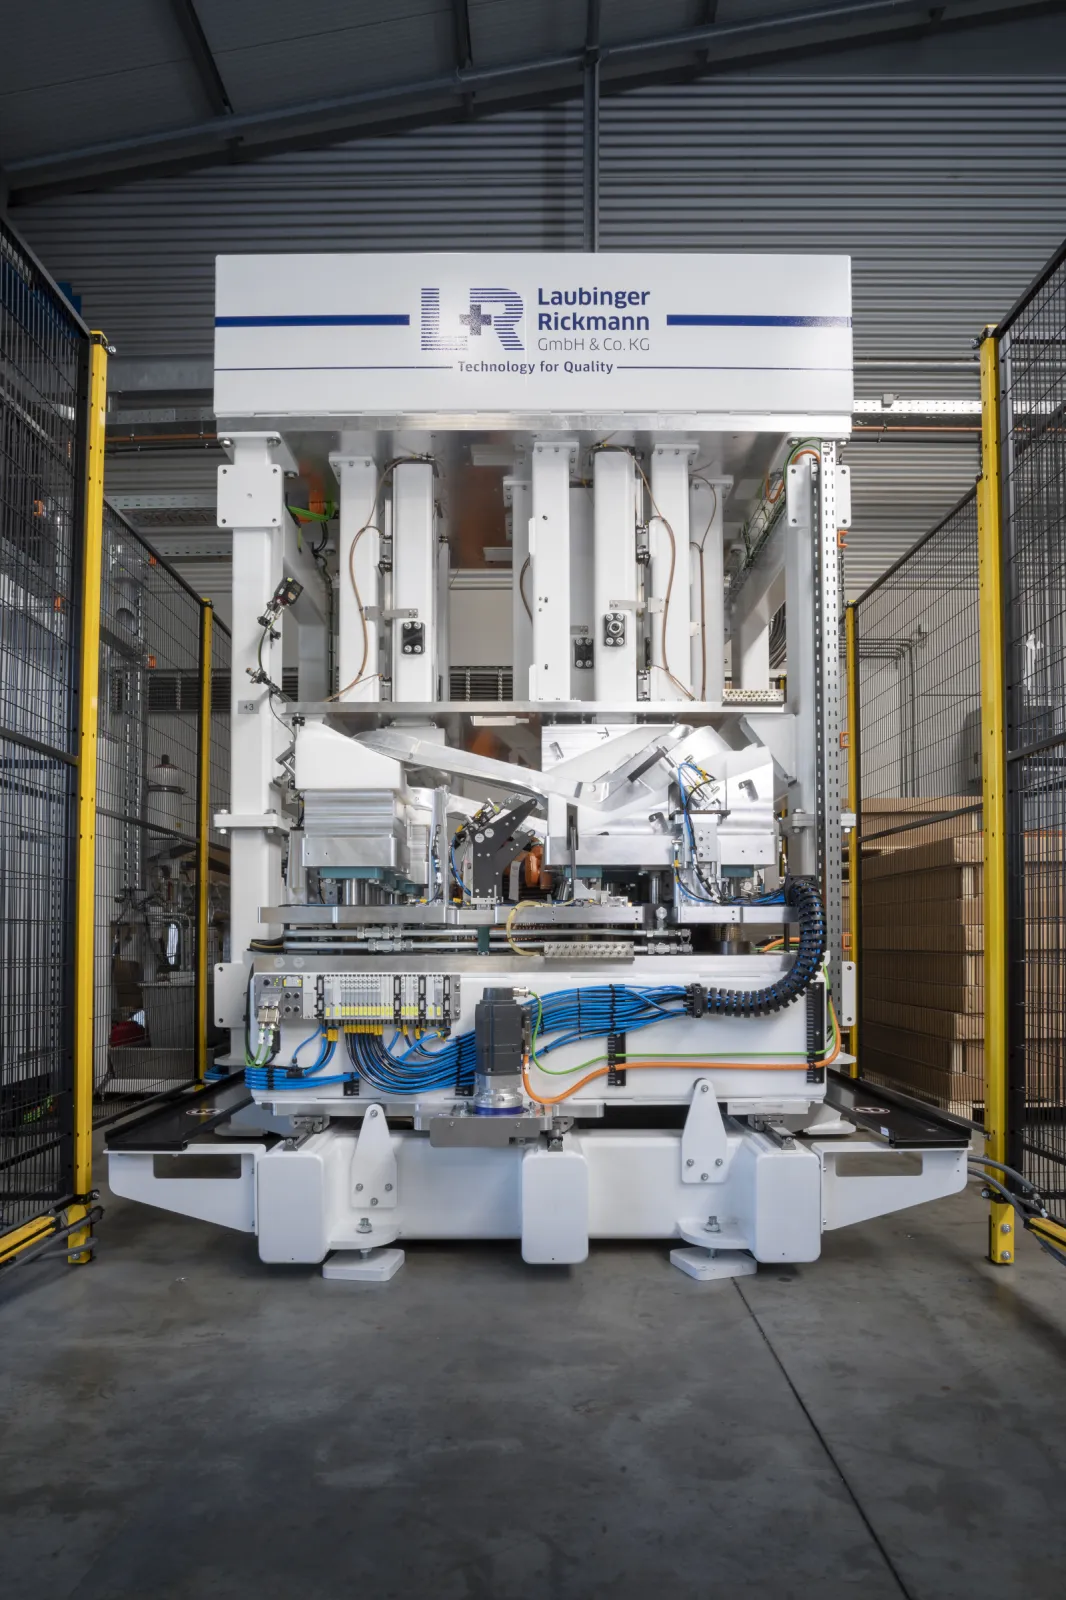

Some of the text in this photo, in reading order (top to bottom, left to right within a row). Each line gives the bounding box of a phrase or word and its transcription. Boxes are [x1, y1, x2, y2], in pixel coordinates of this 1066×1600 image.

[538, 287, 650, 309] Laubinger
[538, 312, 649, 331] Rickmann
[538, 337, 650, 351] GmbH & Co. KG
[458, 360, 614, 375] Technology for Quality
